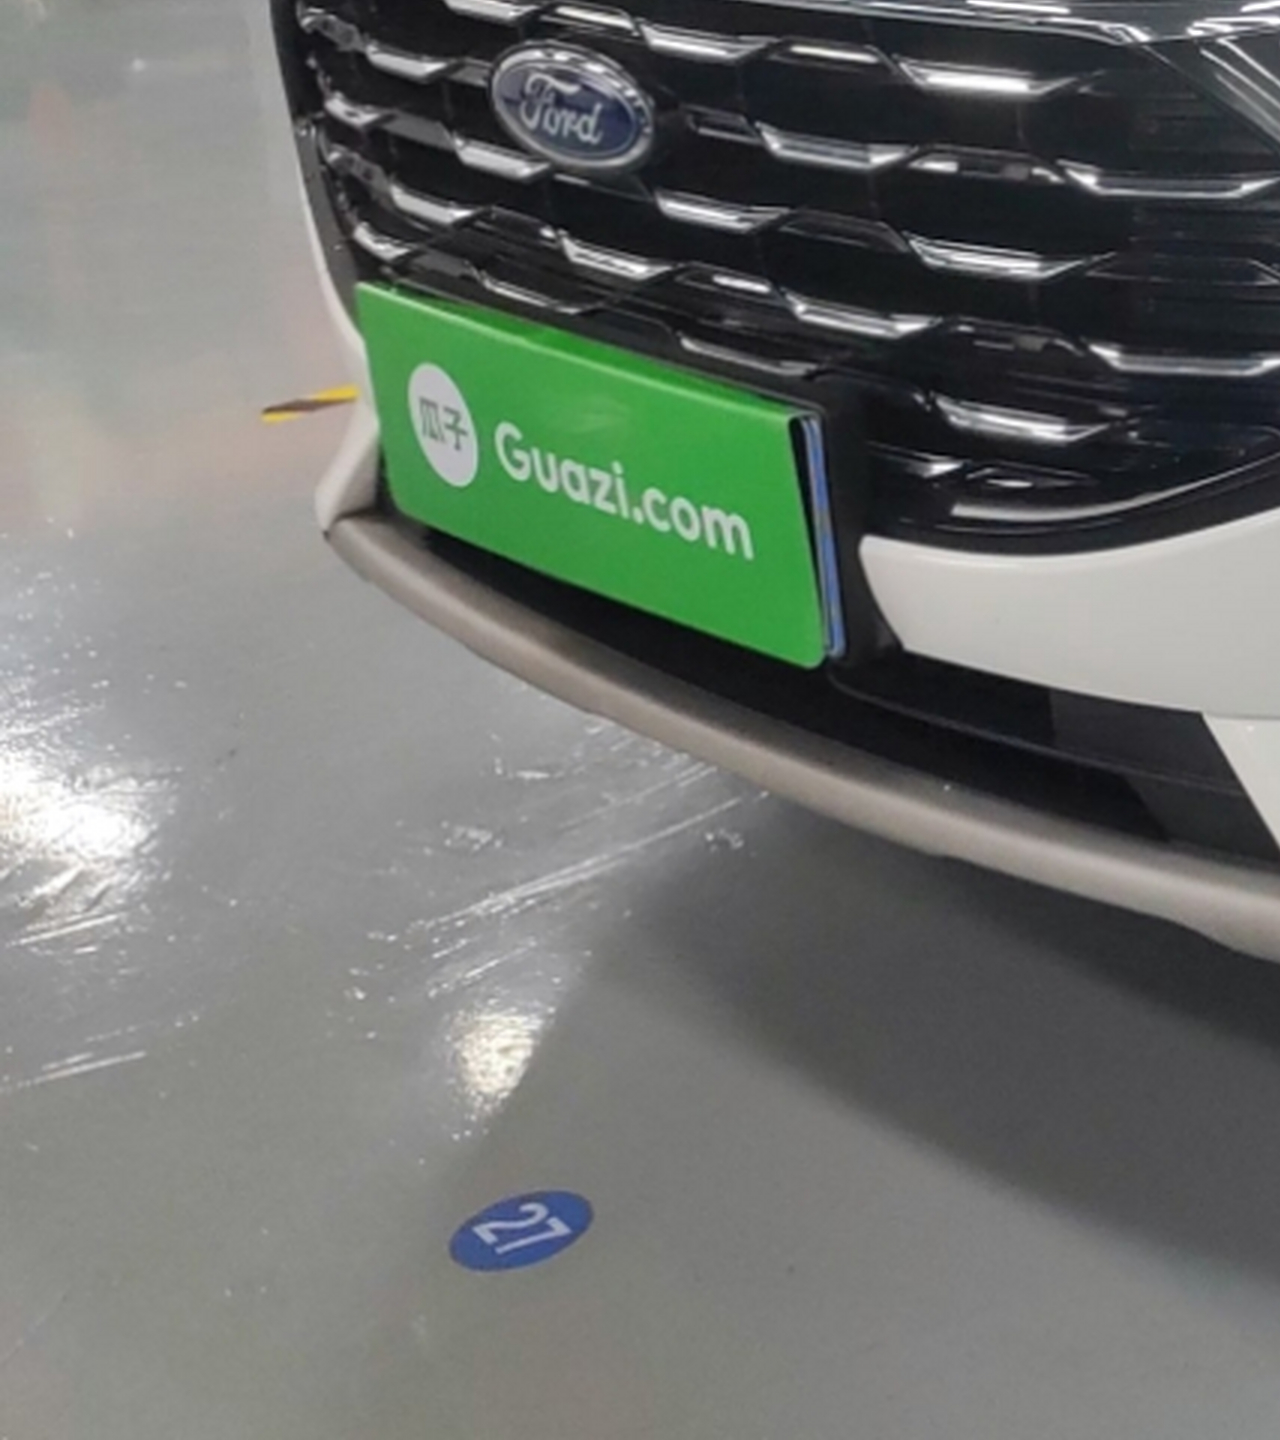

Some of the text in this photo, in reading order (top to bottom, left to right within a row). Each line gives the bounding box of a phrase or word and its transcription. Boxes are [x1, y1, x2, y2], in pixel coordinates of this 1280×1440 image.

[521, 72, 603, 145] Ford
[419, 396, 468, 452] 瓜子
[495, 421, 754, 561] Guazi.com
[472, 1202, 571, 1254] 21
